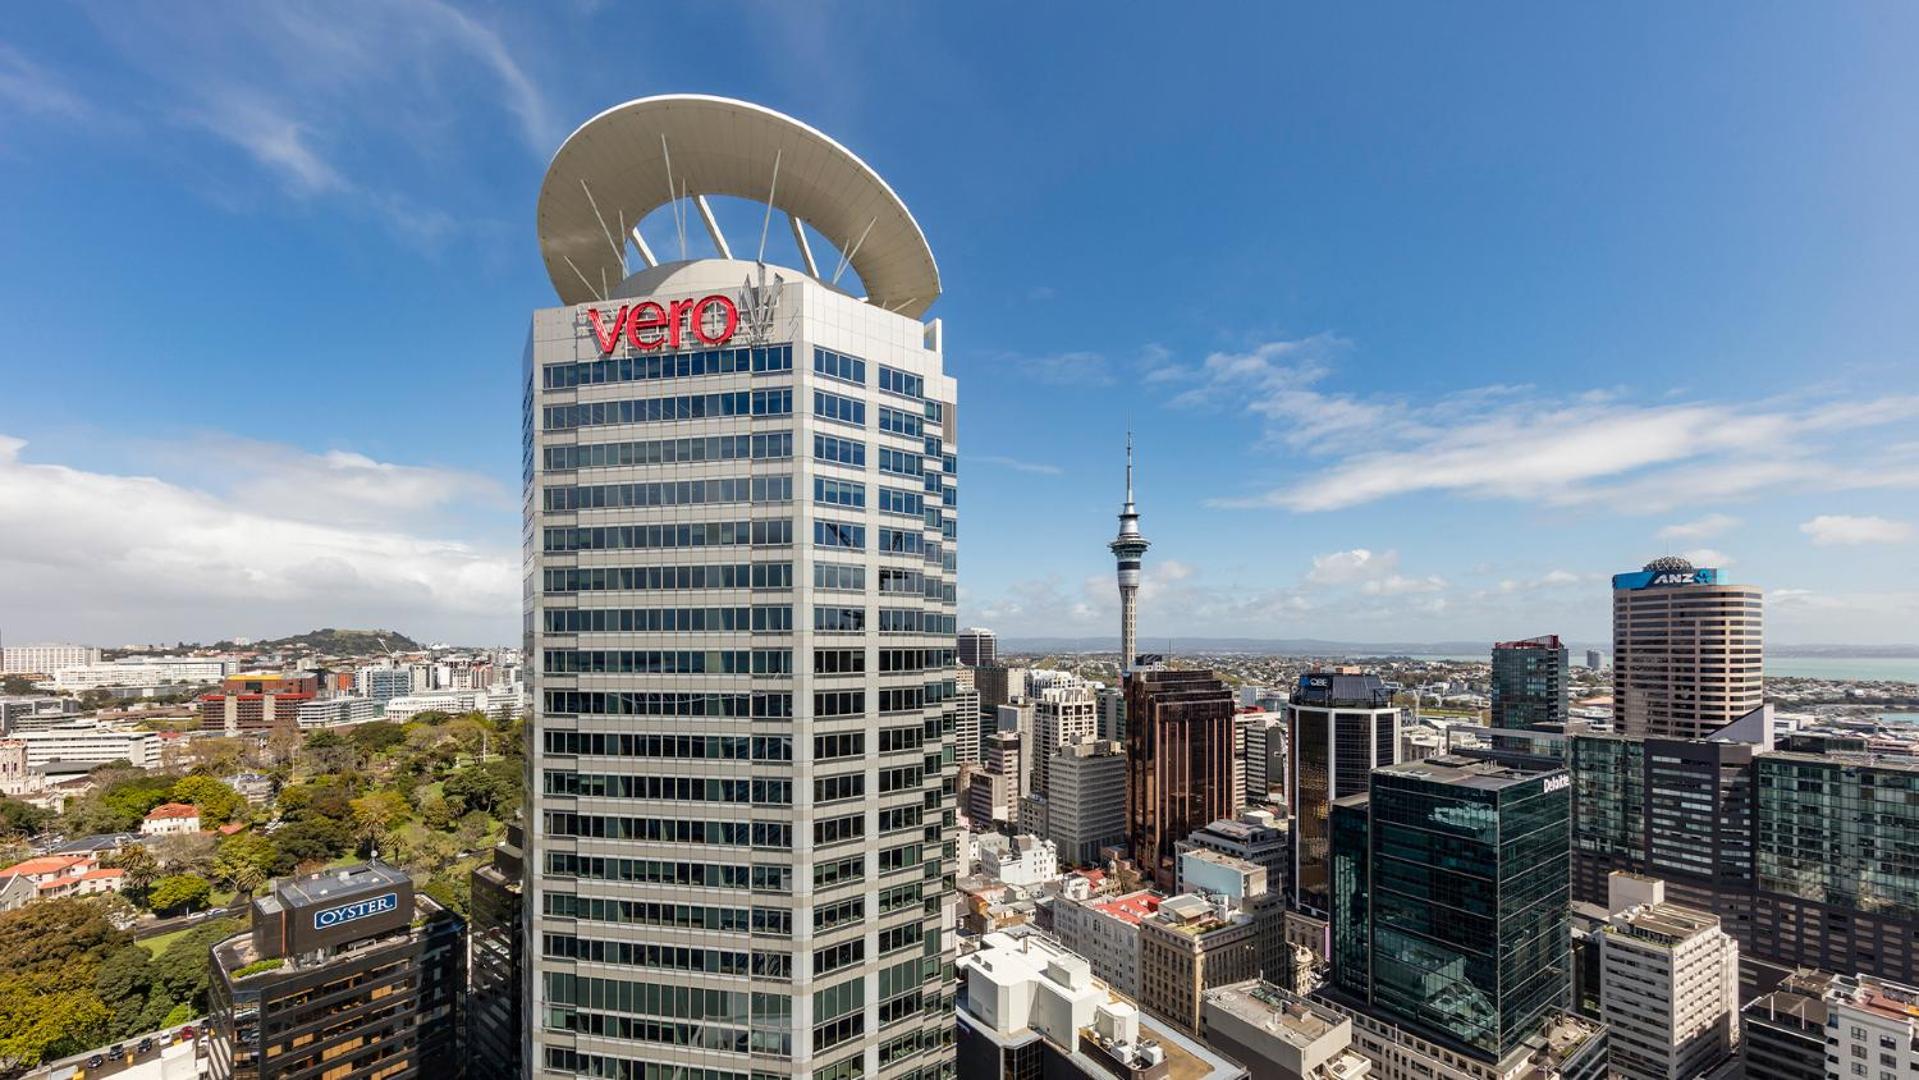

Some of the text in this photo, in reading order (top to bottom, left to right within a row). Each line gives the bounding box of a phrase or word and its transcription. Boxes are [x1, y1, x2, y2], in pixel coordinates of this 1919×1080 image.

[588, 294, 737, 354] vero
[1654, 573, 1694, 584] ANZ
[320, 898, 393, 924] OYSTER
